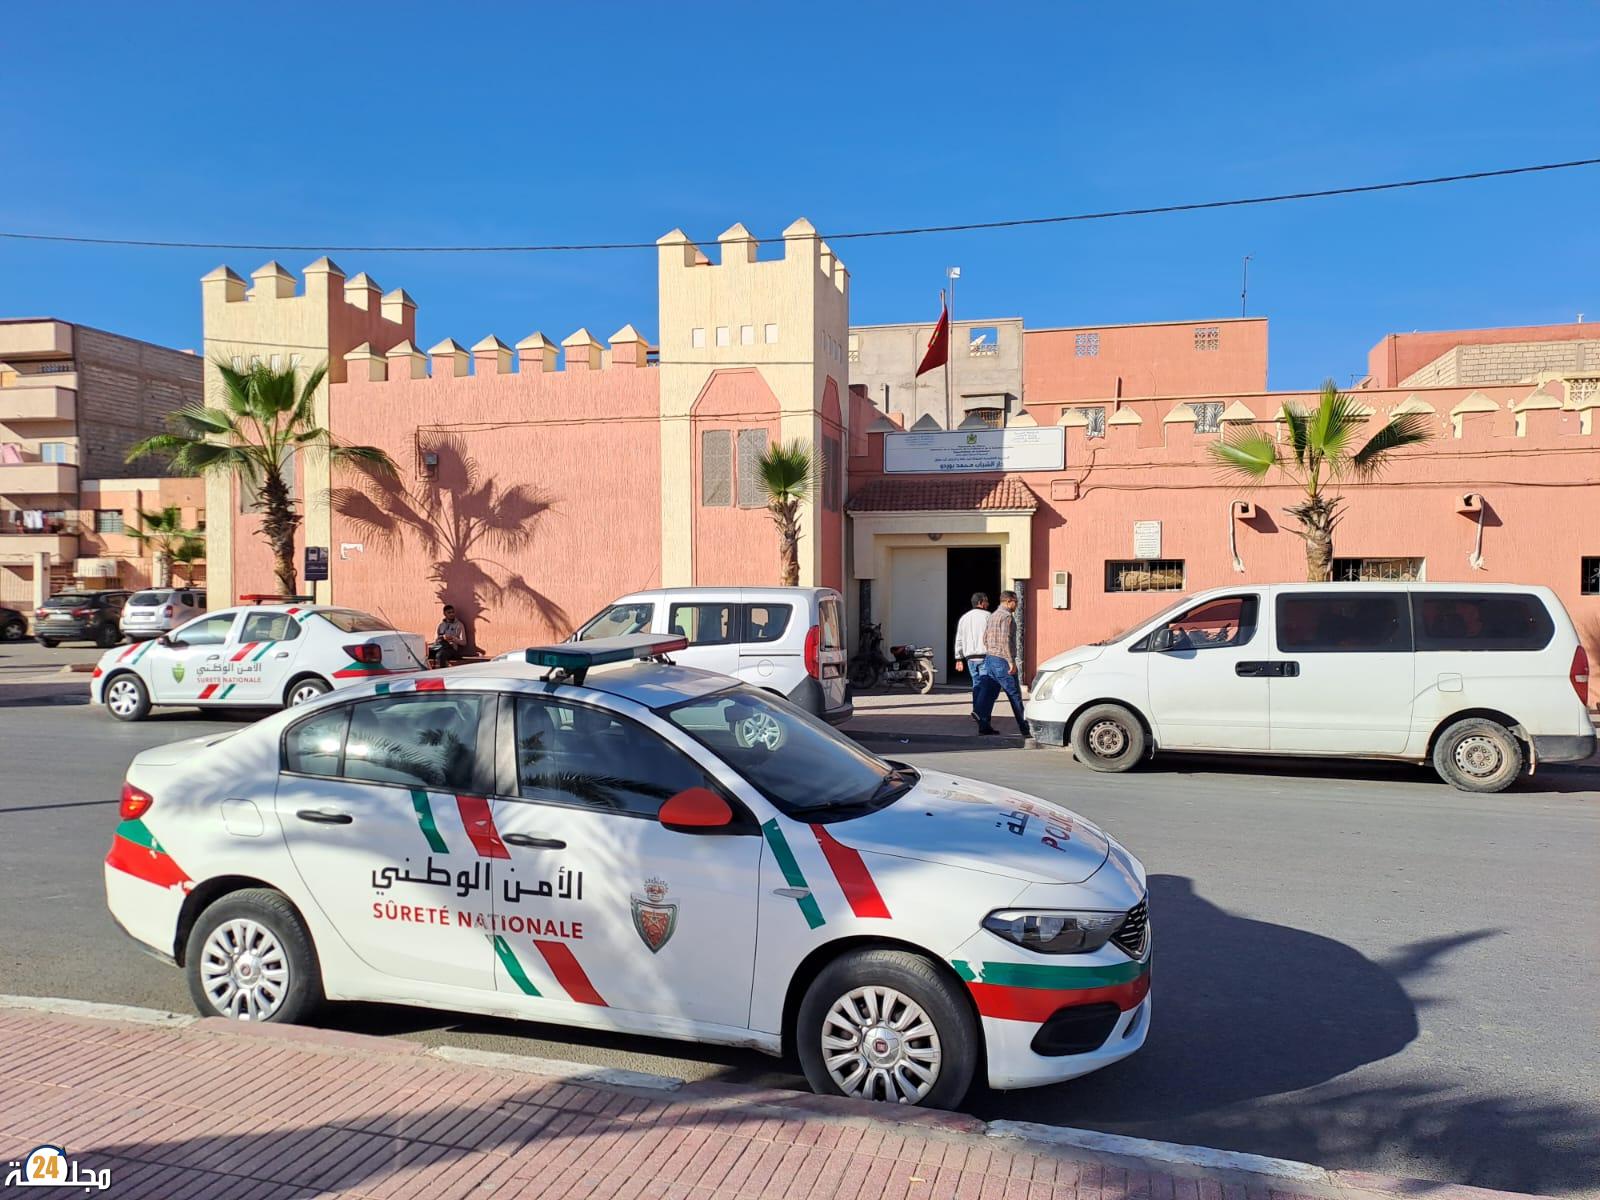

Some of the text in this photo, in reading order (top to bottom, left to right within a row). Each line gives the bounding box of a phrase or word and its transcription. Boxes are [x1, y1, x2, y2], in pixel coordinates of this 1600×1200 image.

[372, 856, 584, 903] الأمن الوطني
[373, 900, 584, 940] SÛRETÉ NATIONALE
